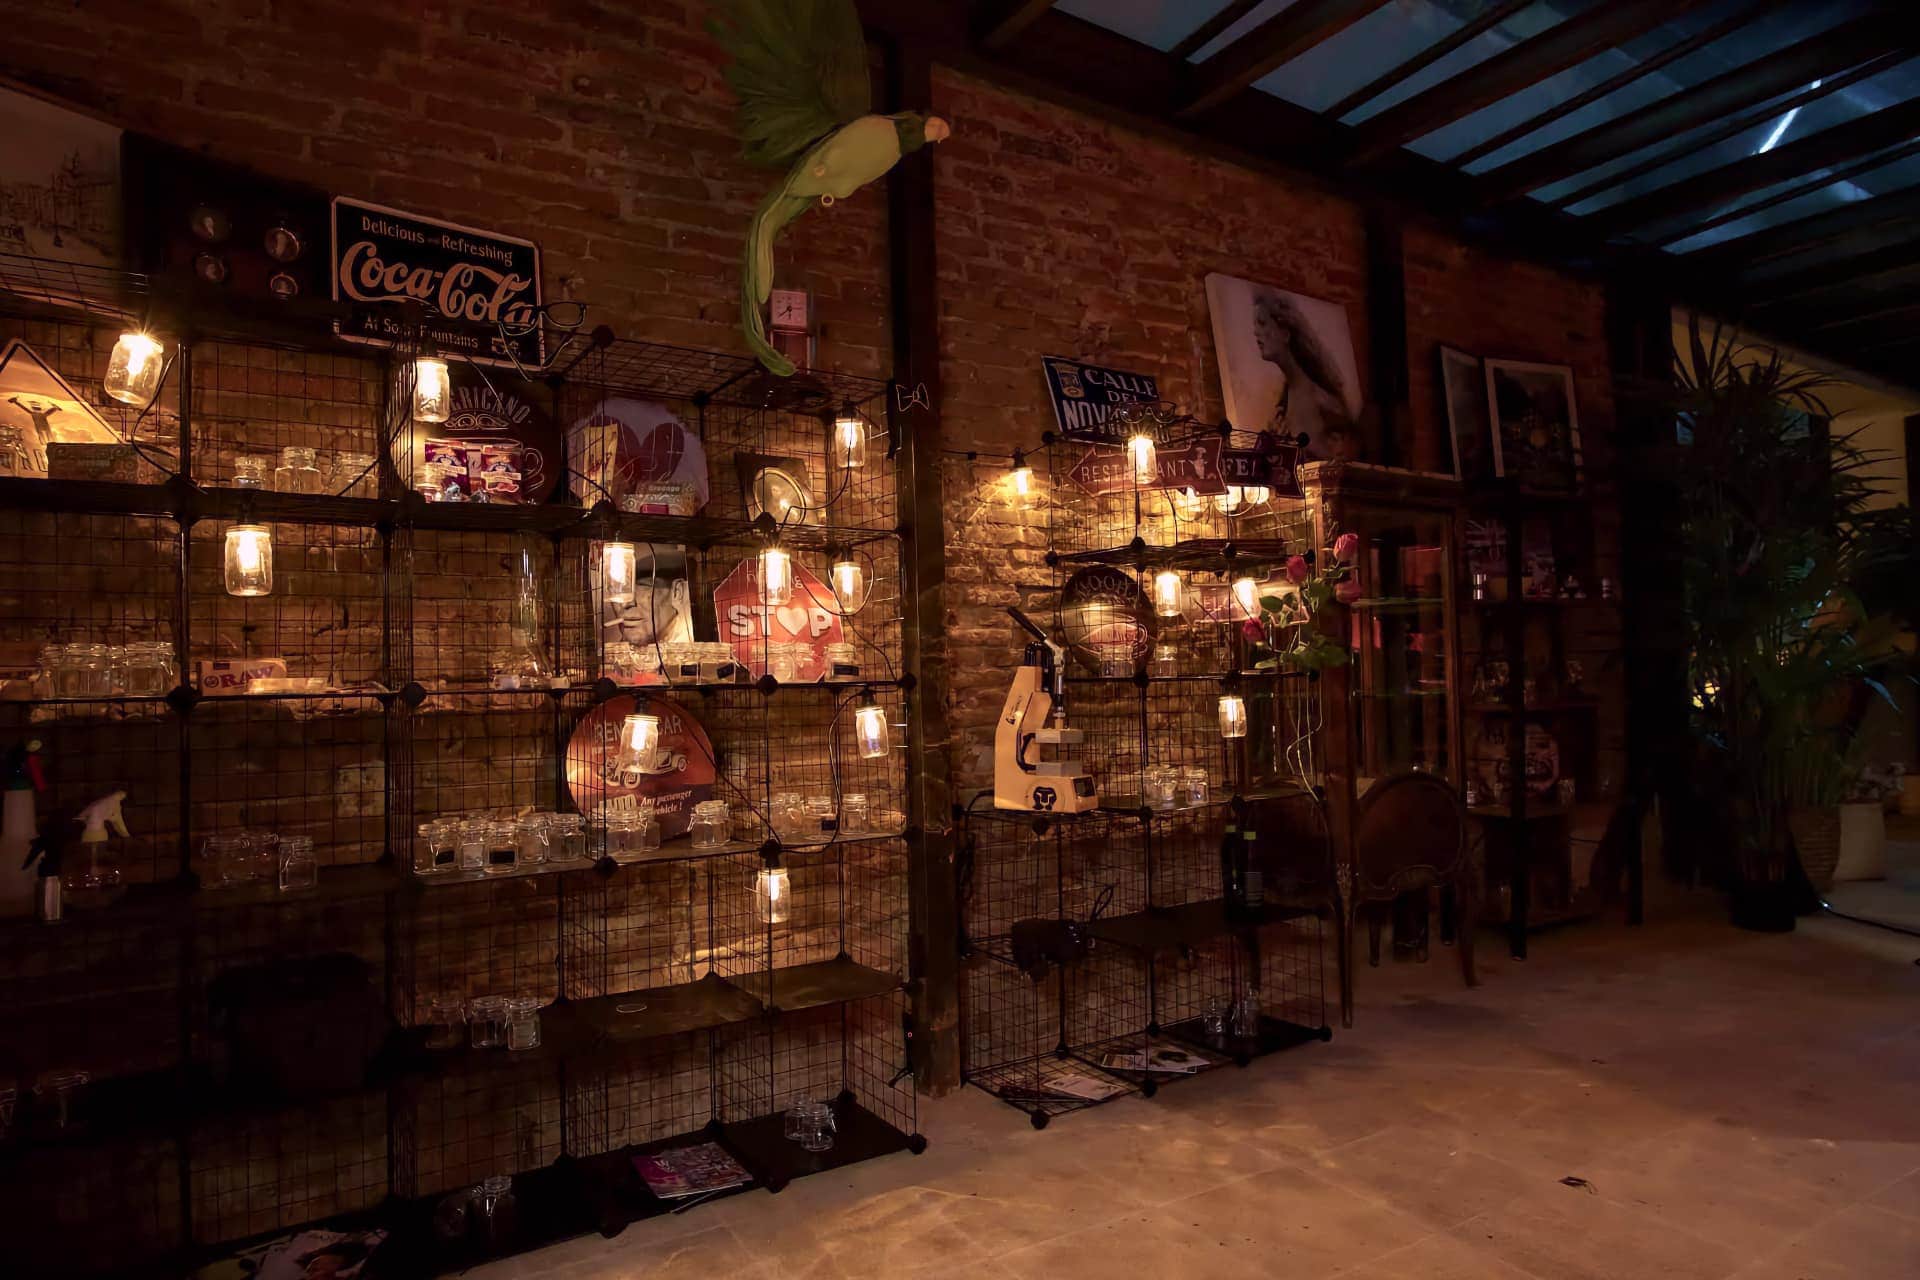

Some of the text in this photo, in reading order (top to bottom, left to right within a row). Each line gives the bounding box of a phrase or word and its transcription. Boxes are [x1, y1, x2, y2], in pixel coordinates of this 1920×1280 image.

[361, 214, 513, 268] Delicious Refreshing
[339, 240, 533, 325] Coca-Cola
[1084, 368, 1158, 399] CALLE
[1081, 459, 1186, 482] RESTAANT
